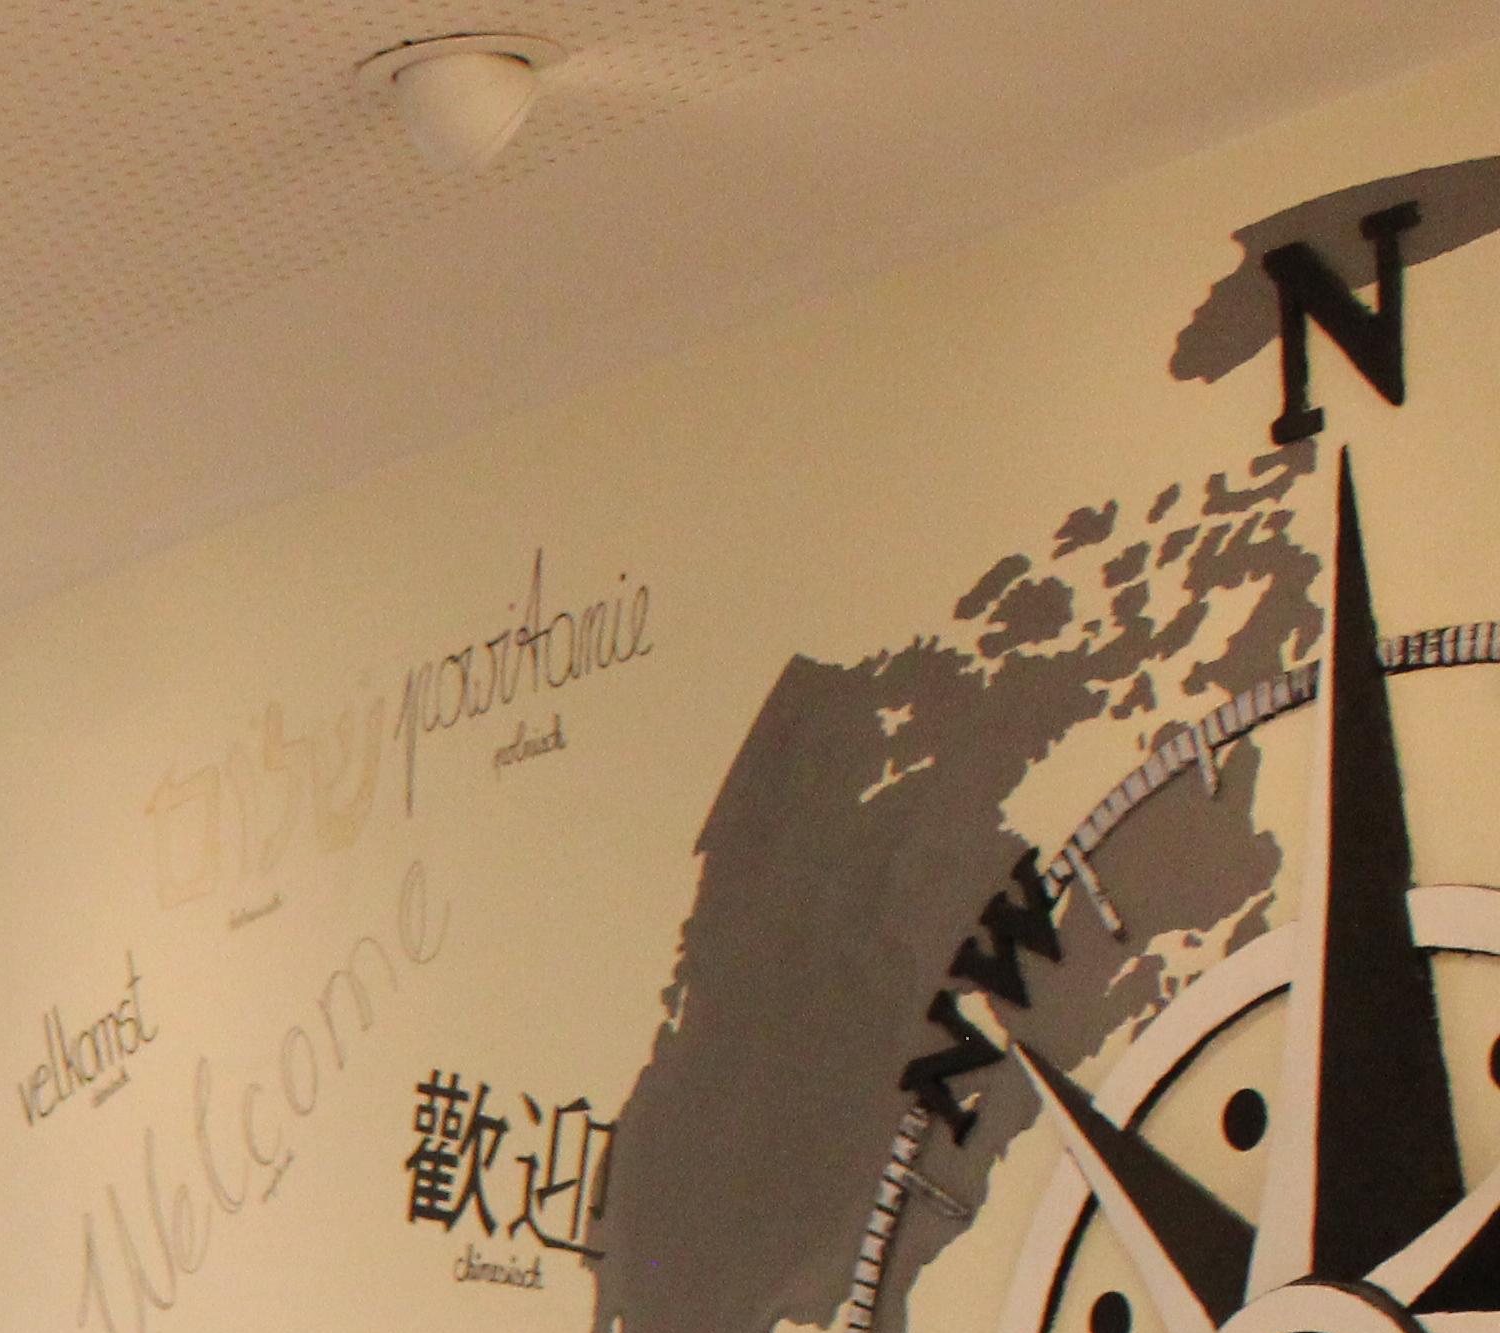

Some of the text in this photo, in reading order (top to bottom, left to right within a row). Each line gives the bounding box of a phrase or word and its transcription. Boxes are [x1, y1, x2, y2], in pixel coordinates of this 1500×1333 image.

[1260, 200, 1423, 446] N
[395, 547, 654, 819] powitanie
[405, 1067, 618, 1261] 歡迎
